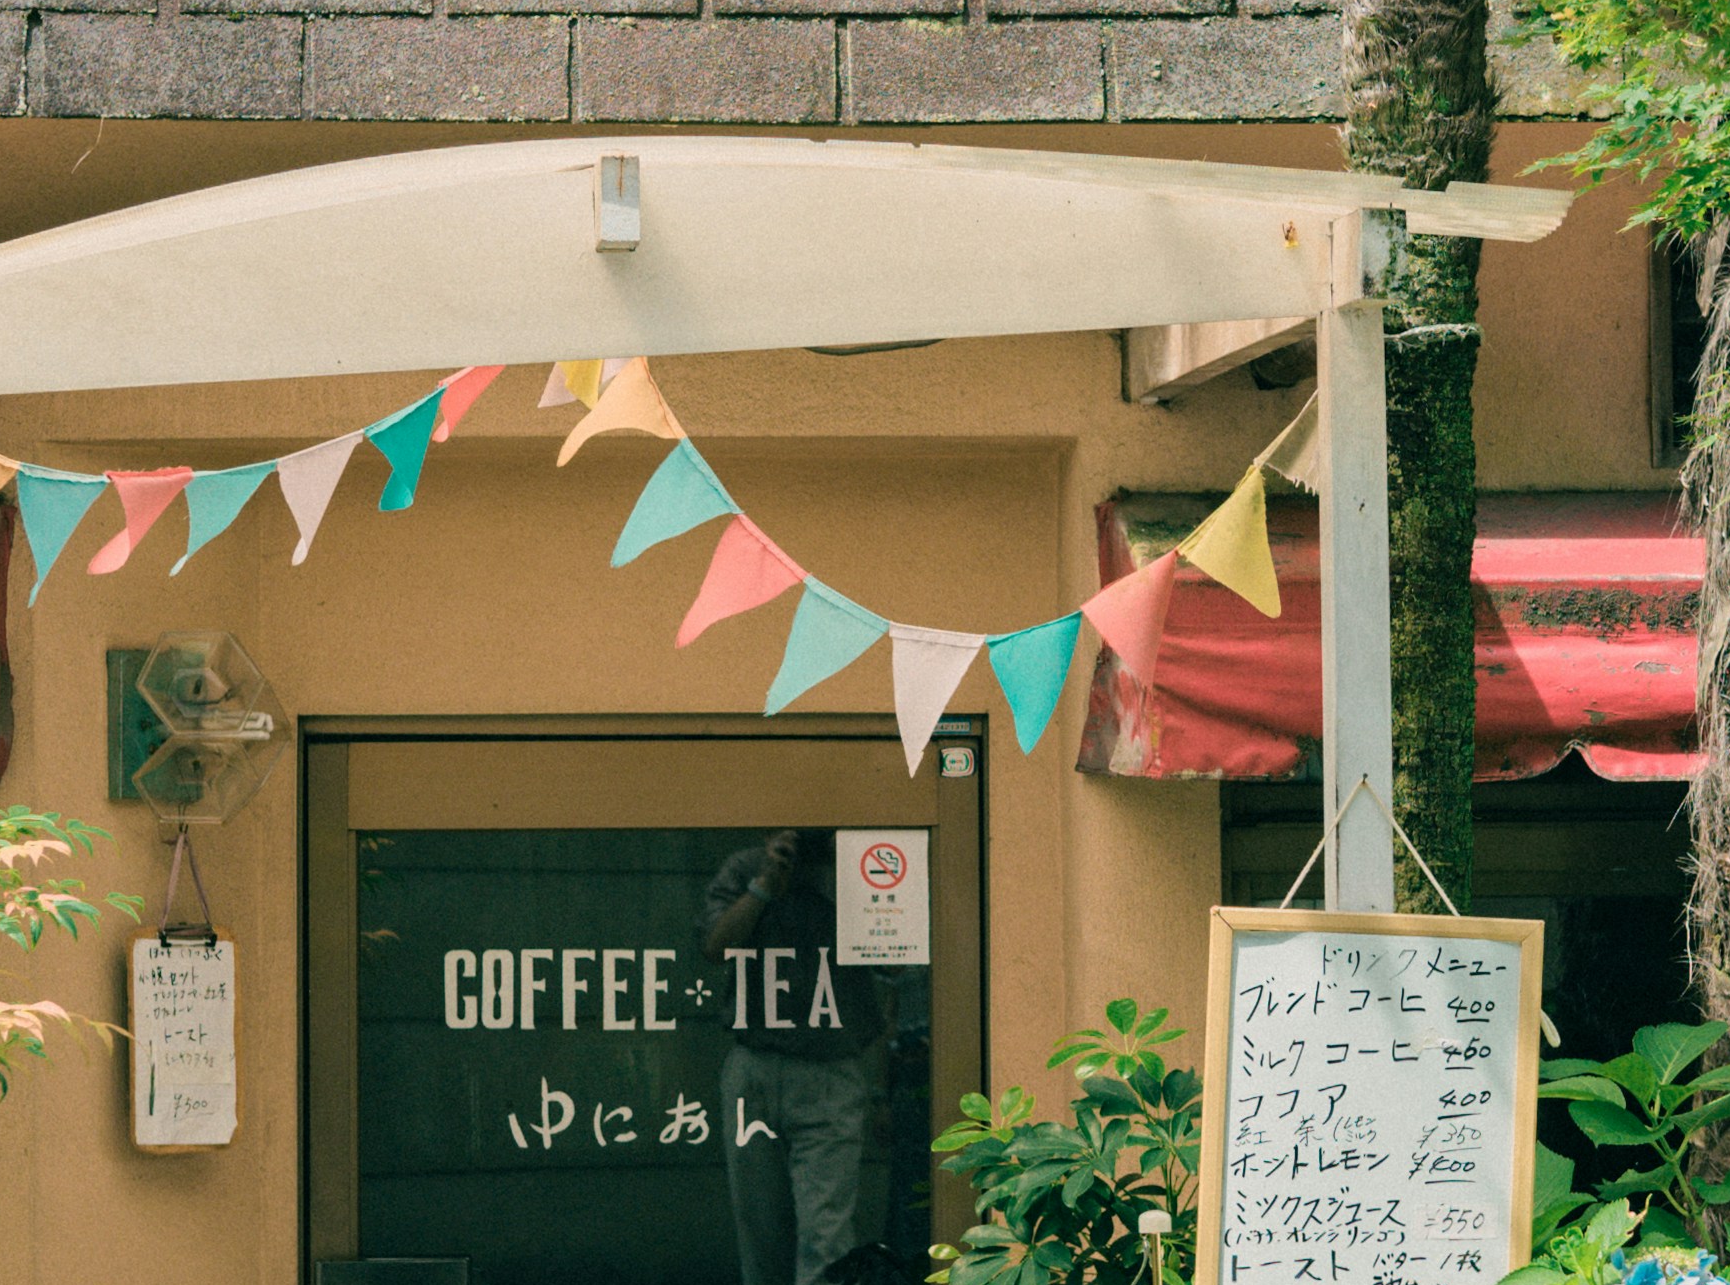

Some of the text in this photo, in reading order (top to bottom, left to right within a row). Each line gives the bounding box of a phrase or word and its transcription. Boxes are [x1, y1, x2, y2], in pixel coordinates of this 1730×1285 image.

[443, 947, 843, 1030] COFFEE TEA
[1447, 1000, 1495, 1017] 400
[508, 1076, 777, 1148] ゆにおん
[1438, 1090, 1491, 1107] 400
[1232, 1250, 1350, 1281] トースト
